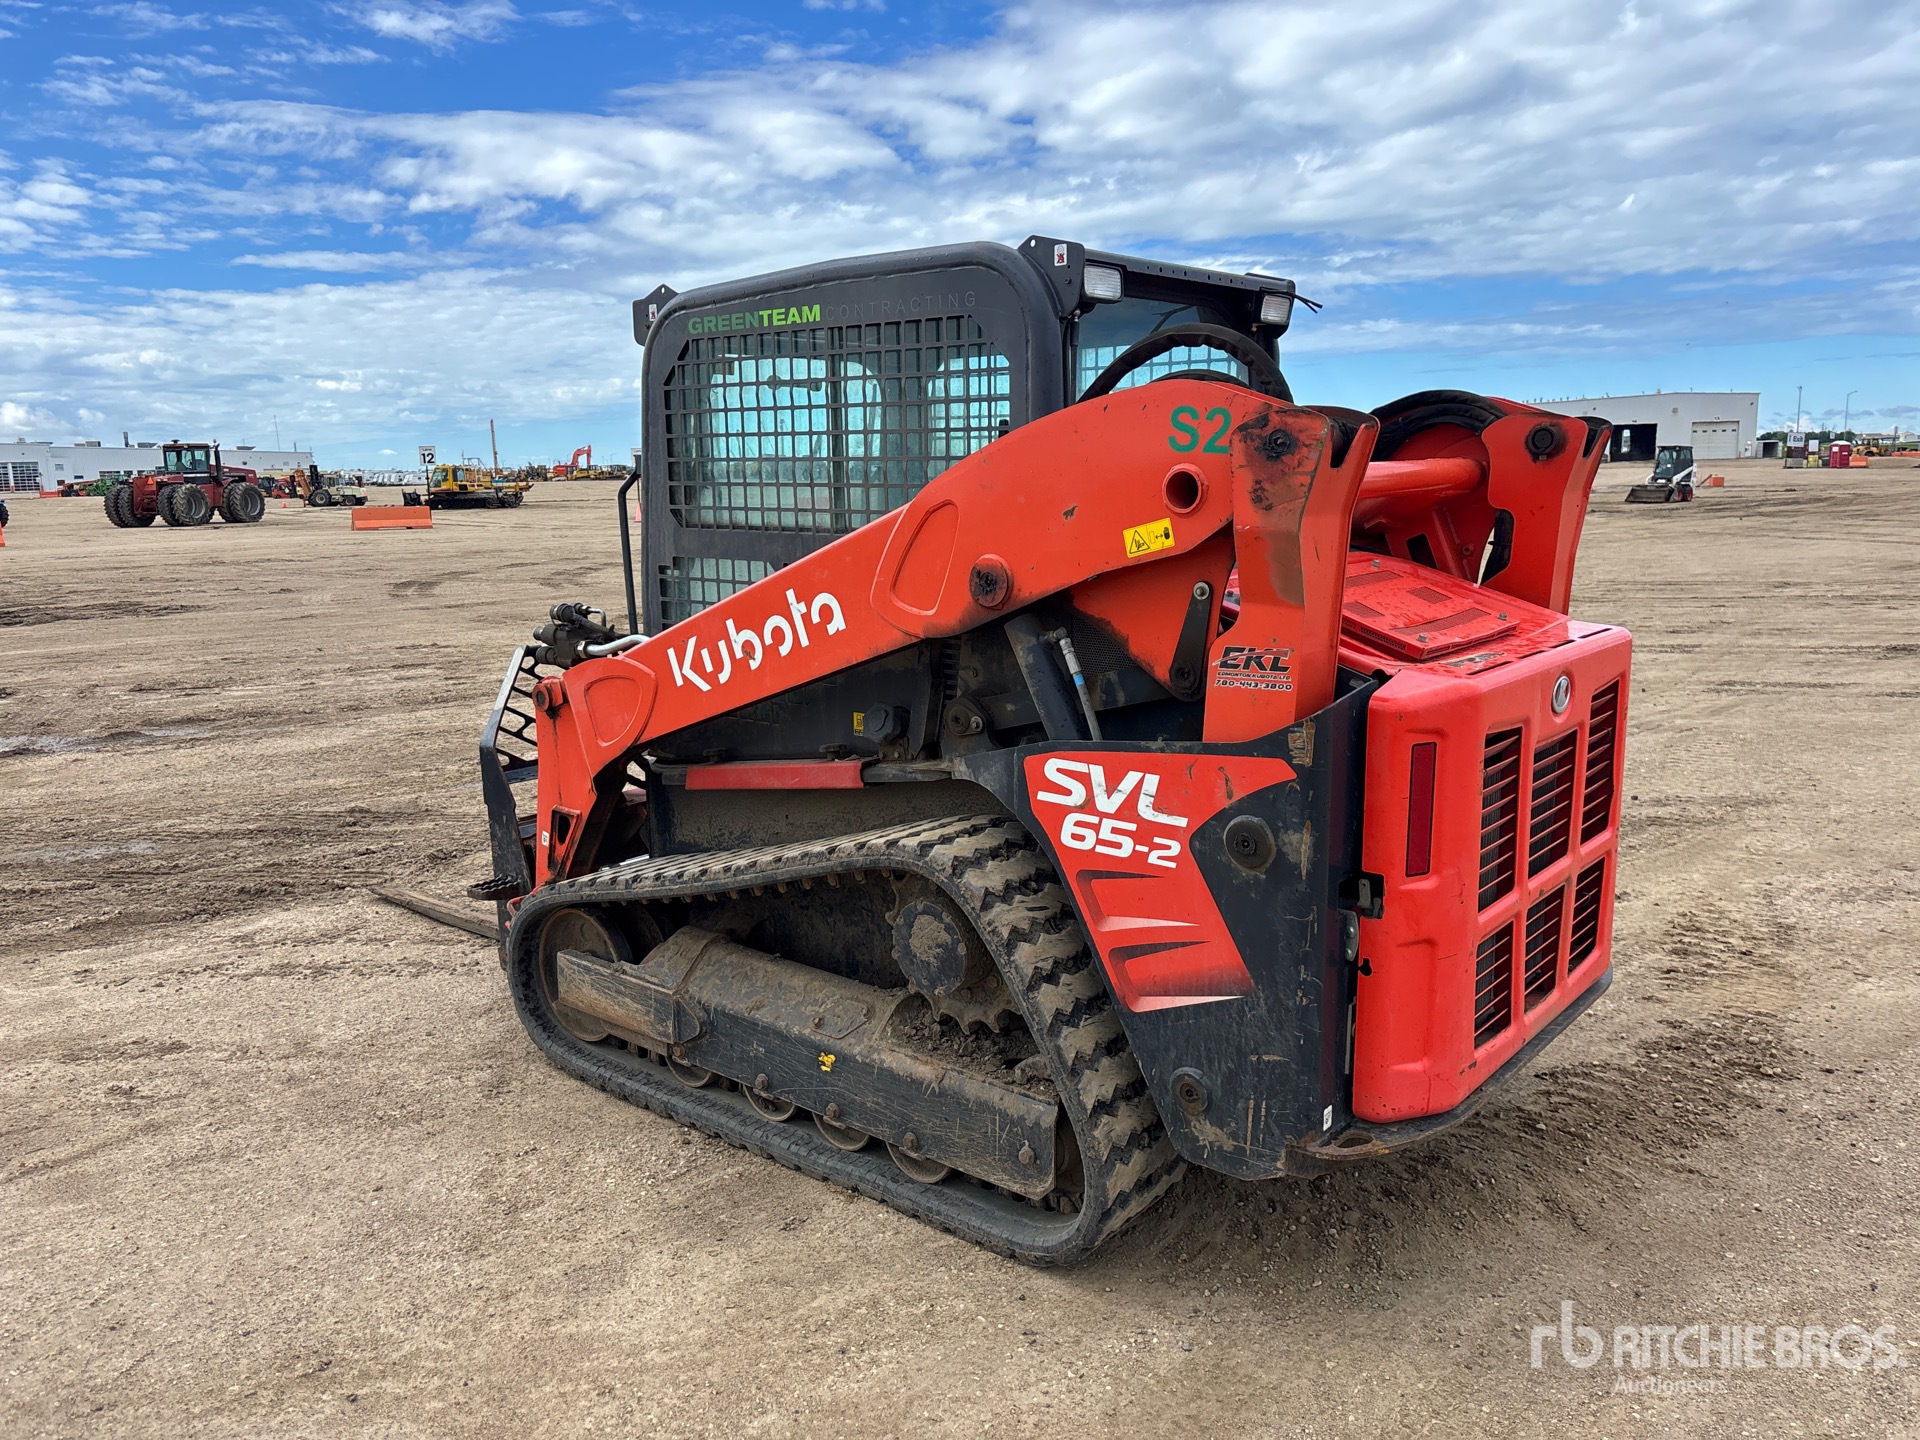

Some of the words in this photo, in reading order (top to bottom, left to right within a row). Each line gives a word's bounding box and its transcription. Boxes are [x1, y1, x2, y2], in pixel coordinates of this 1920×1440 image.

[826, 291, 976, 320] CONTRACTING
[1168, 405, 1232, 454] S2
[421, 452, 435, 464] 12
[667, 588, 846, 692] Kubota
[1215, 679, 1292, 691] 780-443-3800
[1217, 671, 1251, 680] EDMONTON
[1037, 757, 1189, 828] SVL
[1060, 812, 1182, 869] 65-2
